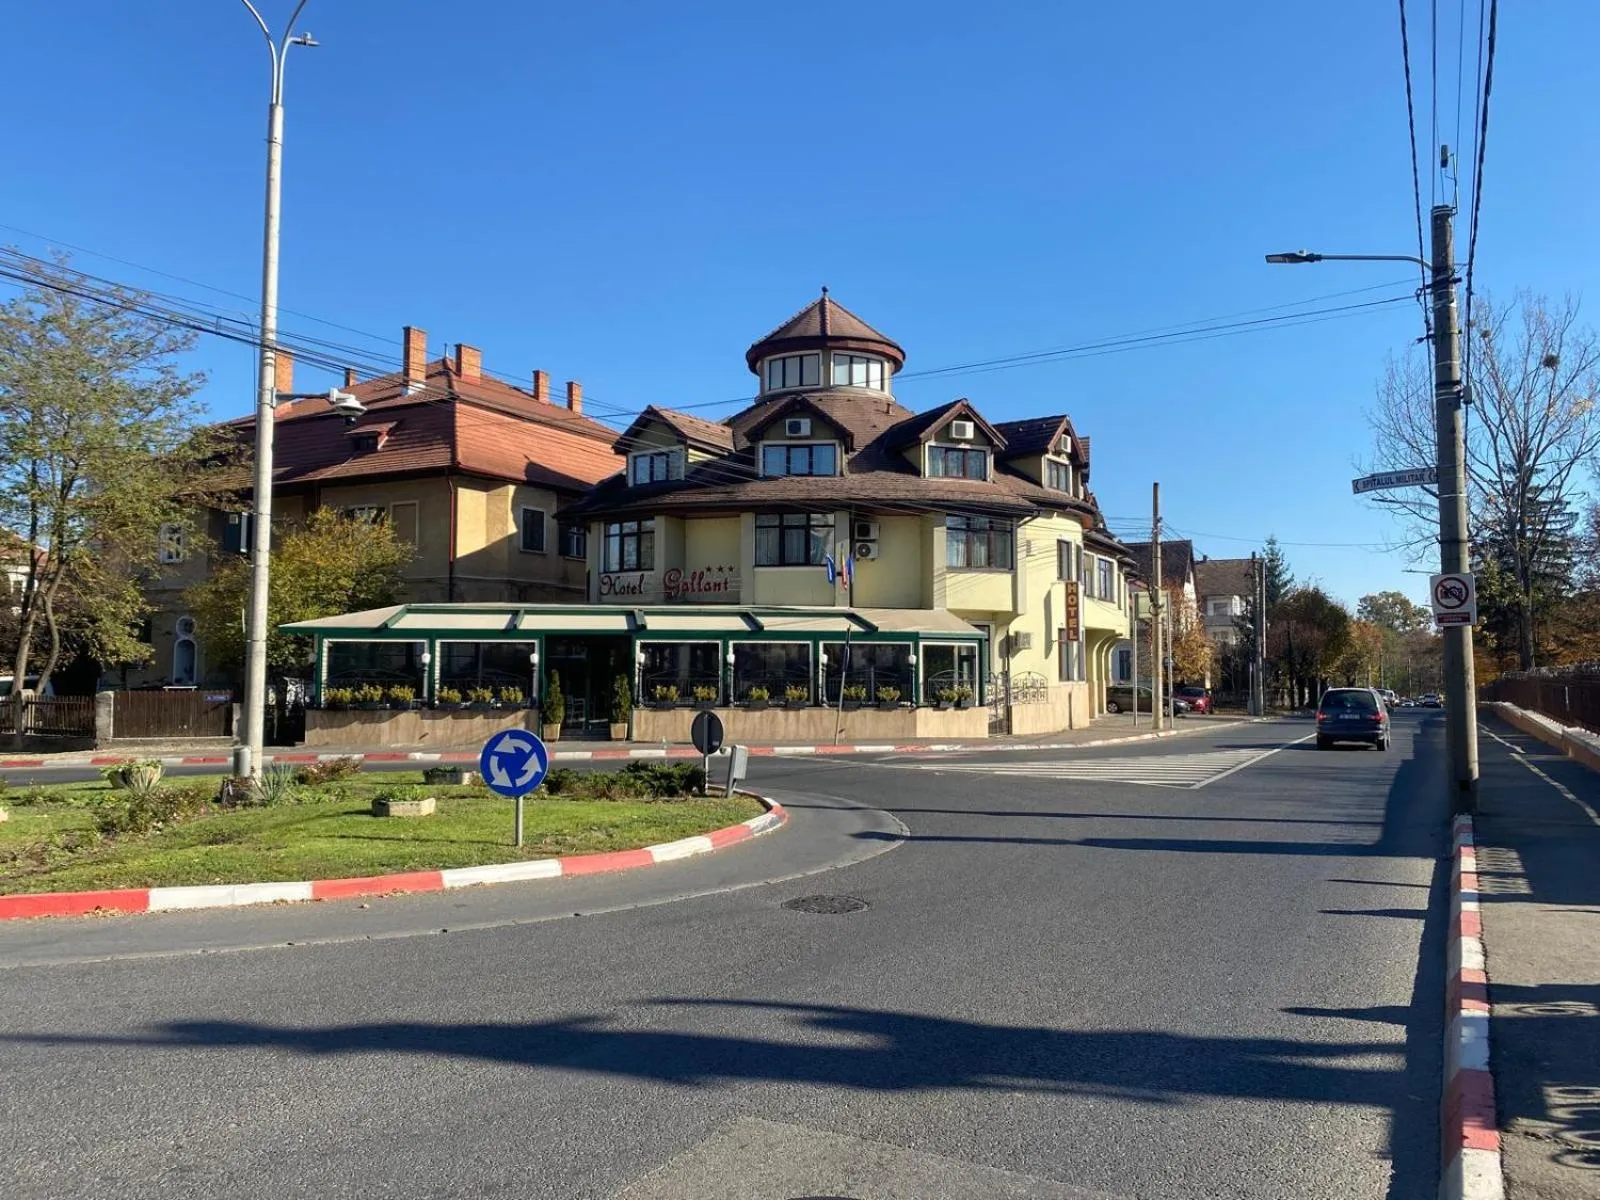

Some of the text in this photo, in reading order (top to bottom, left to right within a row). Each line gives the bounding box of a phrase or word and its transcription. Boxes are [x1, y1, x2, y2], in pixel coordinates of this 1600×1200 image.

[1362, 473, 1425, 489] SPITALUL MILITAR
[600, 568, 728, 598] Hotel Gallant
[1067, 583, 1078, 640] HOTEL
